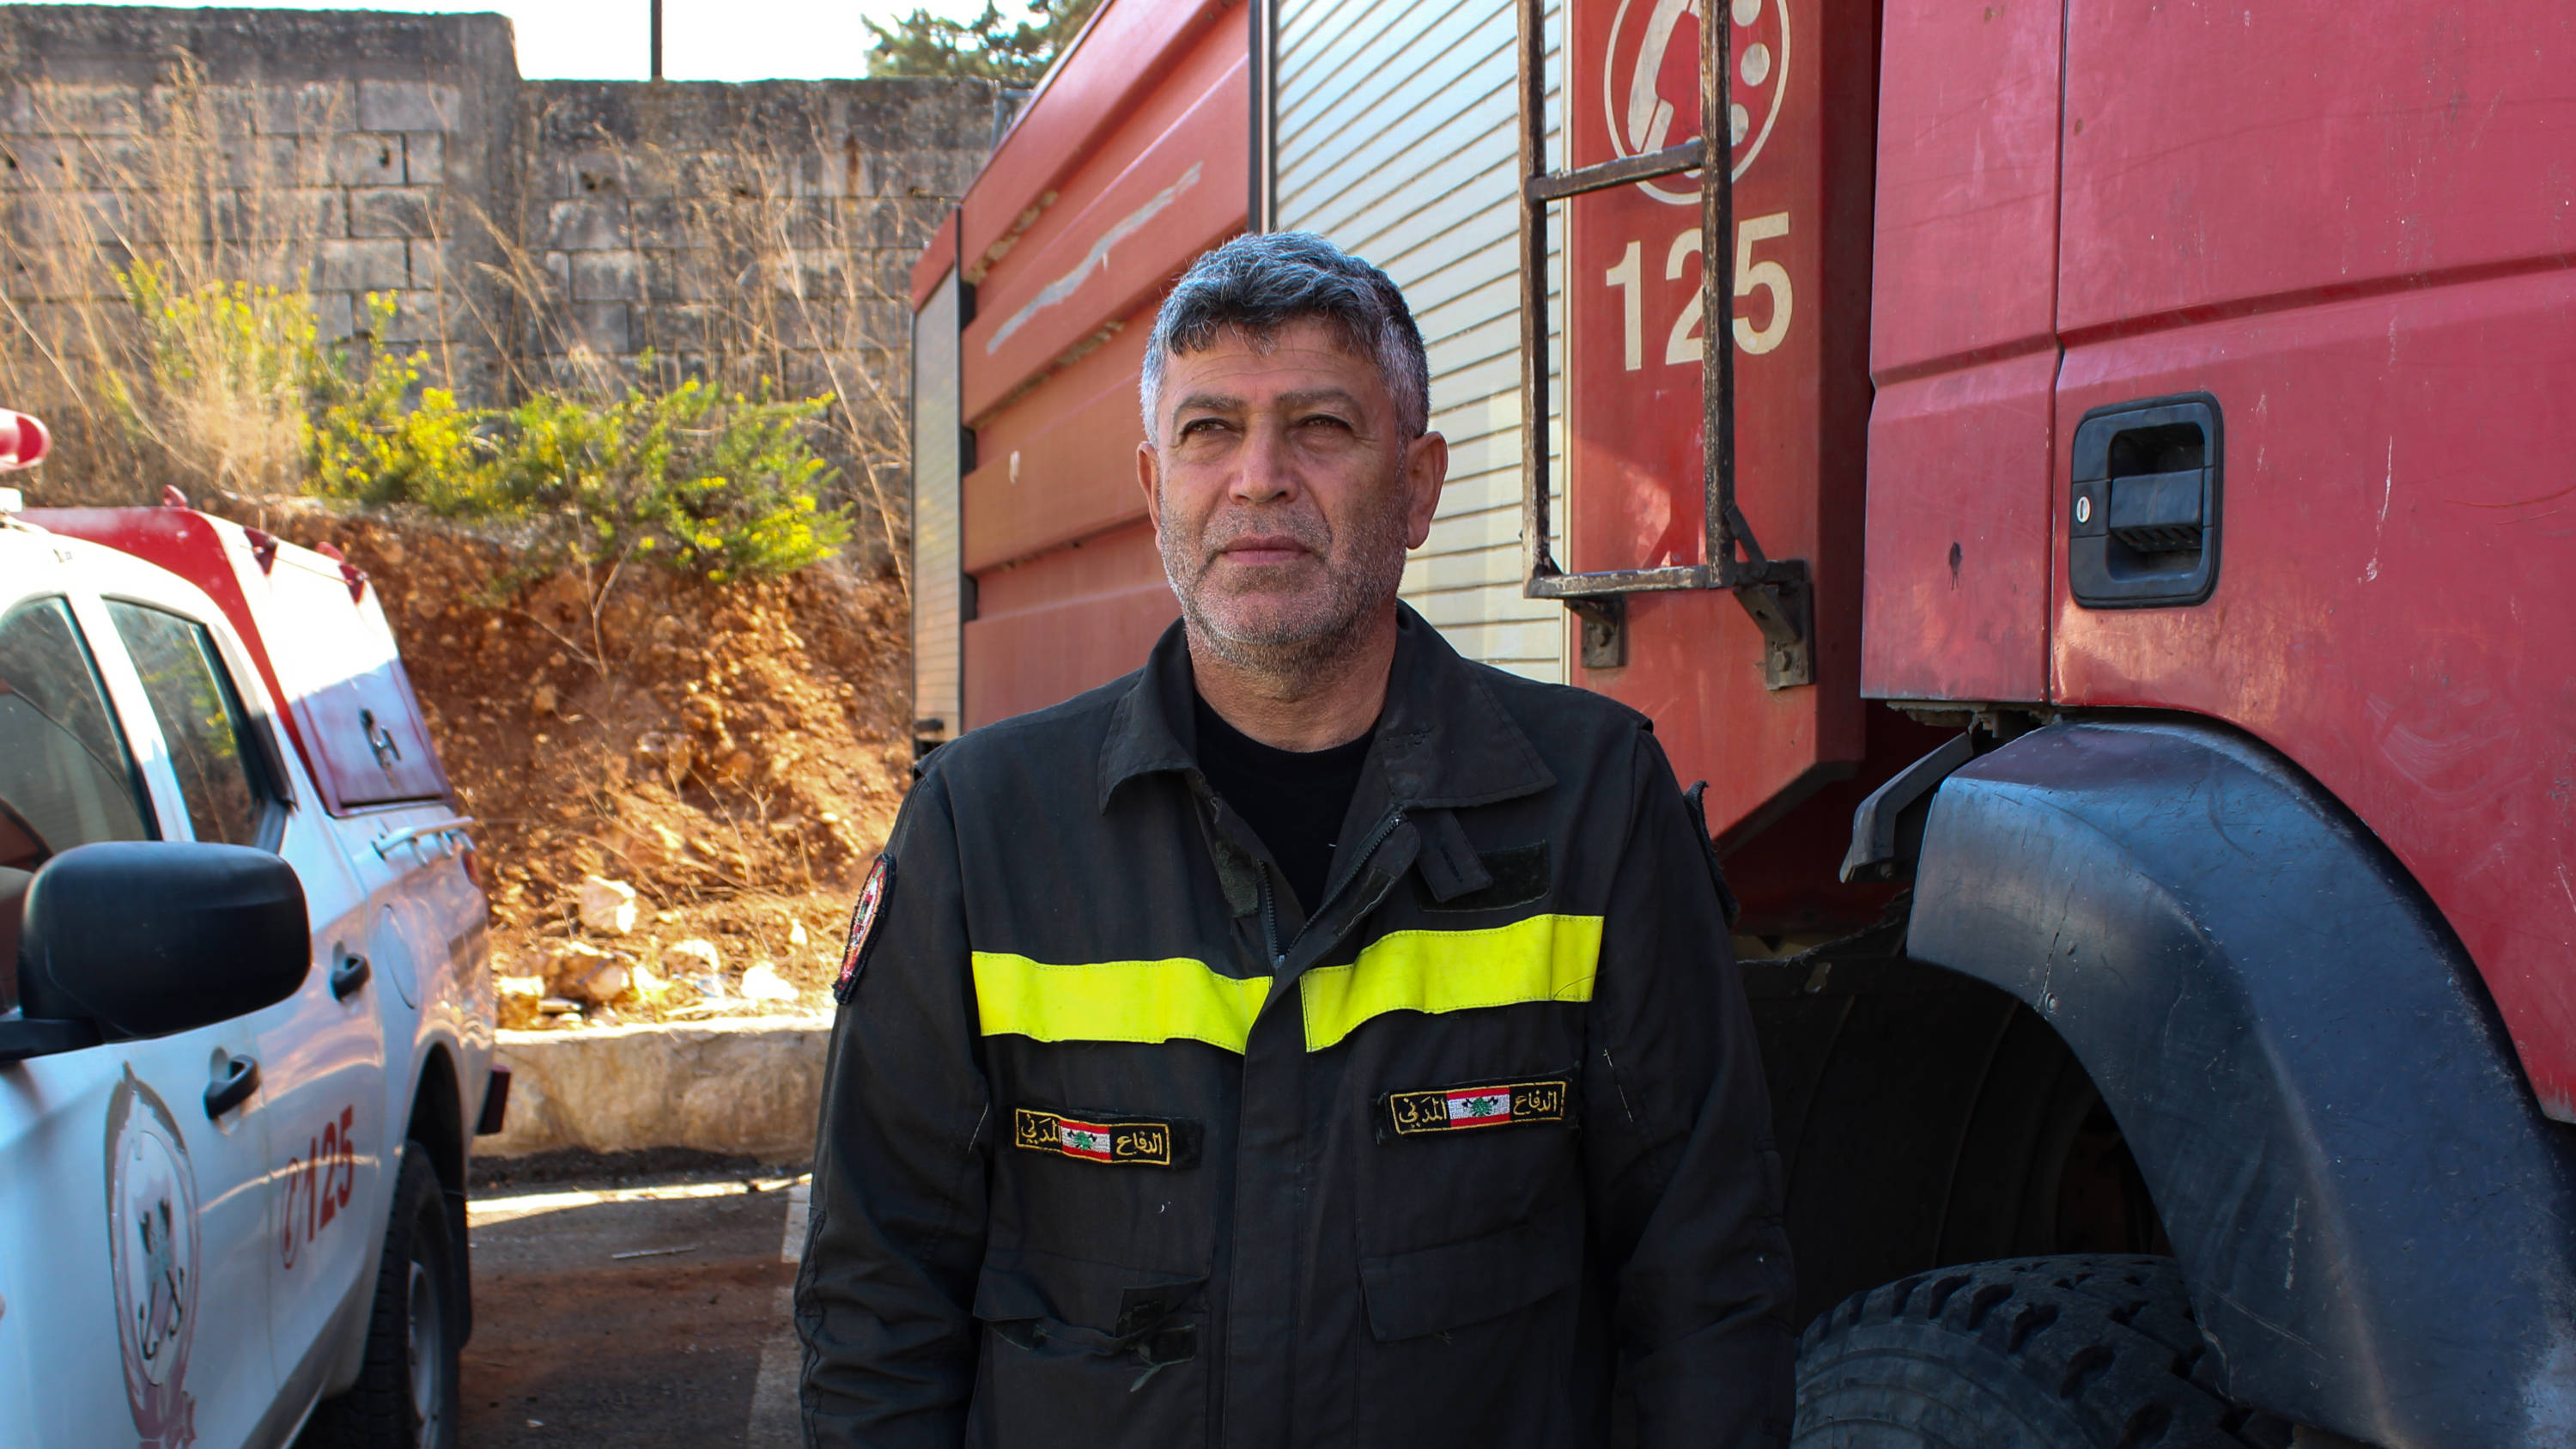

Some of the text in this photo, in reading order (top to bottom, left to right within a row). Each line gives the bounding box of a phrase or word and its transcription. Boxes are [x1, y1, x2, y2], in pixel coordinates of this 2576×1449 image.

[1606, 211, 1793, 371] 125
[1116, 1131, 1163, 1155] الدفاع
[1513, 1089, 1557, 1116] الدفاع
[303, 1105, 355, 1244] 125
